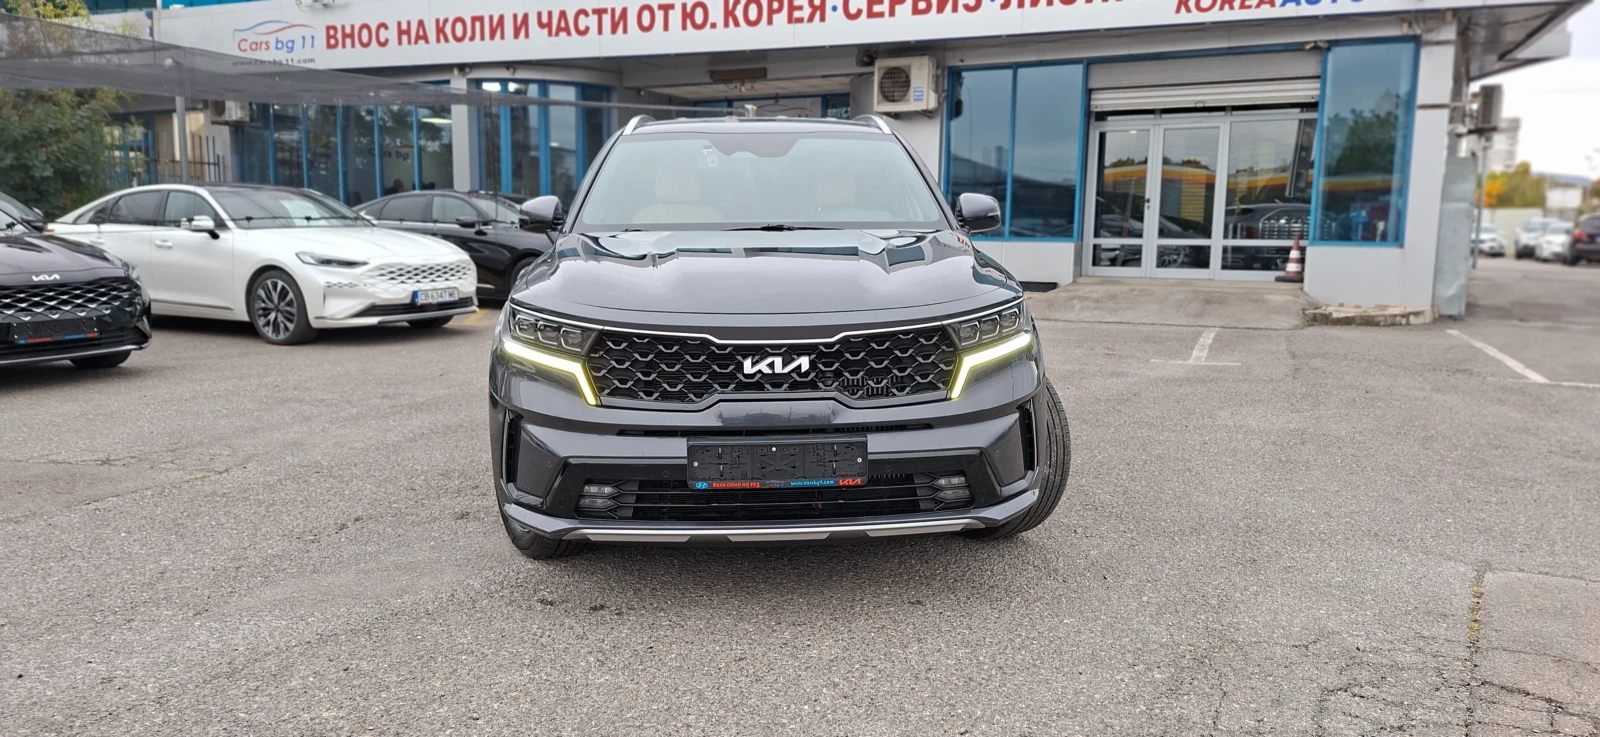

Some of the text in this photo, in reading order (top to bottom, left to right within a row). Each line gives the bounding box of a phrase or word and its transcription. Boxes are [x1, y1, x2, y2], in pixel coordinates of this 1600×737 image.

[325, 22, 389, 50] ВНОС
[397, 19, 430, 46] НА
[435, 14, 505, 44] КОЛИ
[512, 13, 530, 40] И
[536, 7, 628, 38] ЧАСТИ
[636, 3, 675, 33] ОТ
[681, 1, 717, 31] Ю.
[723, 0, 826, 28] КОРЕЯ
[237, 34, 316, 54] Cars bg 11
[31, 273, 60, 281] KIA
[743, 355, 810, 374] KIA
[839, 478, 862, 487] KIA
